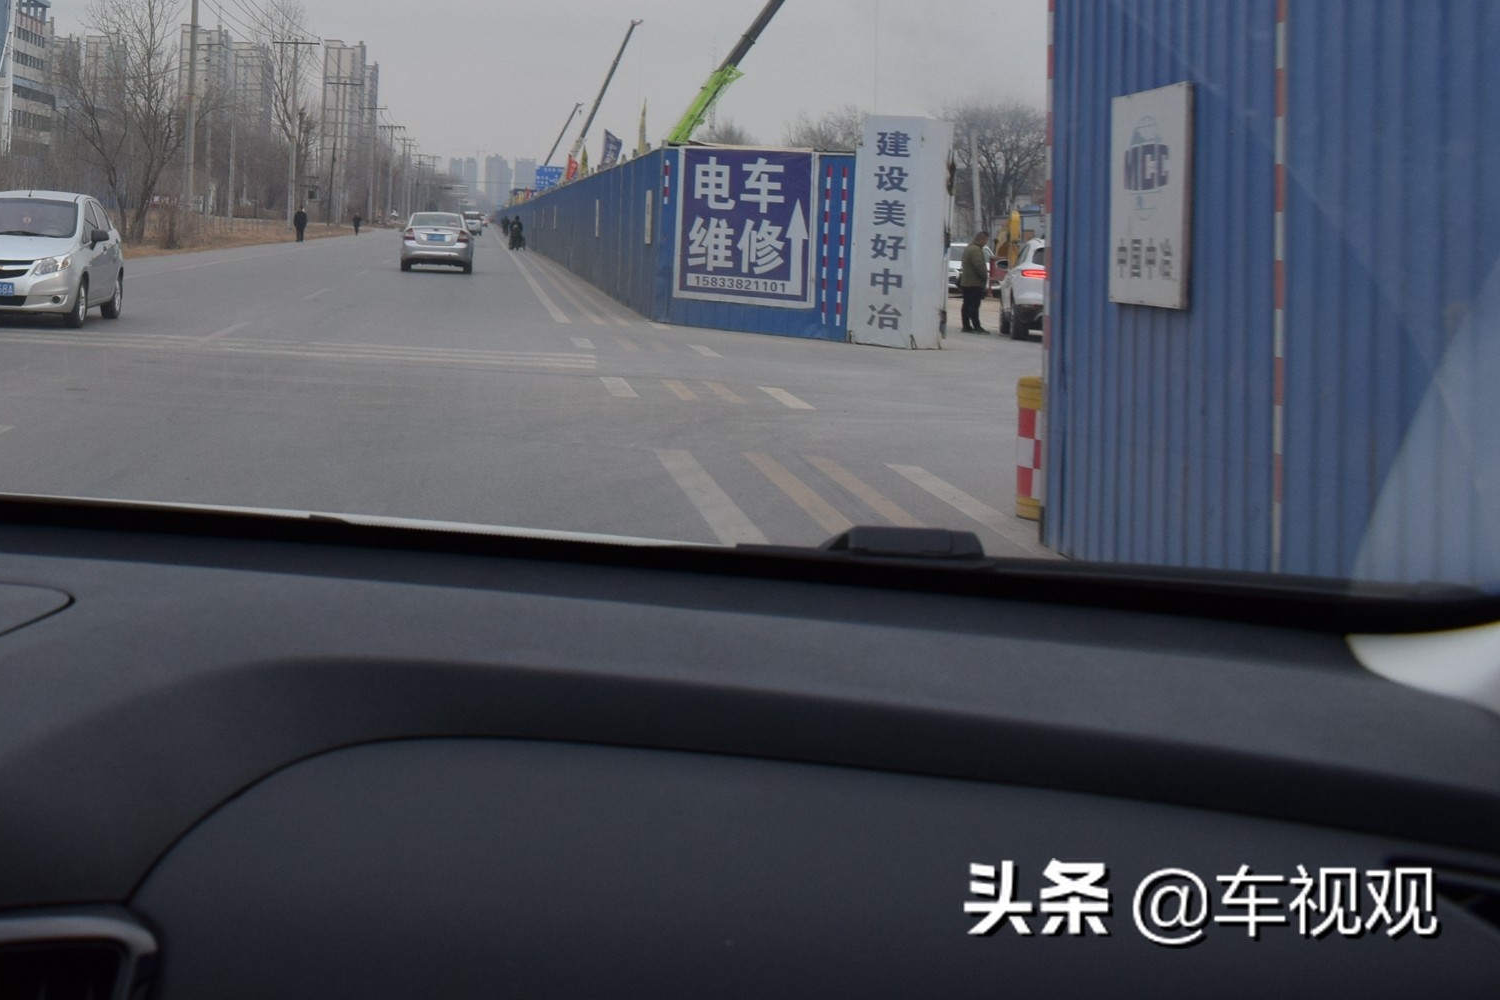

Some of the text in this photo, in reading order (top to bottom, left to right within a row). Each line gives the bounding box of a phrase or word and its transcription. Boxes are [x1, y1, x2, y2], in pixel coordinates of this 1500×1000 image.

[694, 156, 786, 214] 电车
[1123, 143, 1170, 191] MCC
[687, 215, 785, 275] 维修
[867, 130, 911, 331] 建设美好中冶
[695, 275, 787, 293] 15833821101
